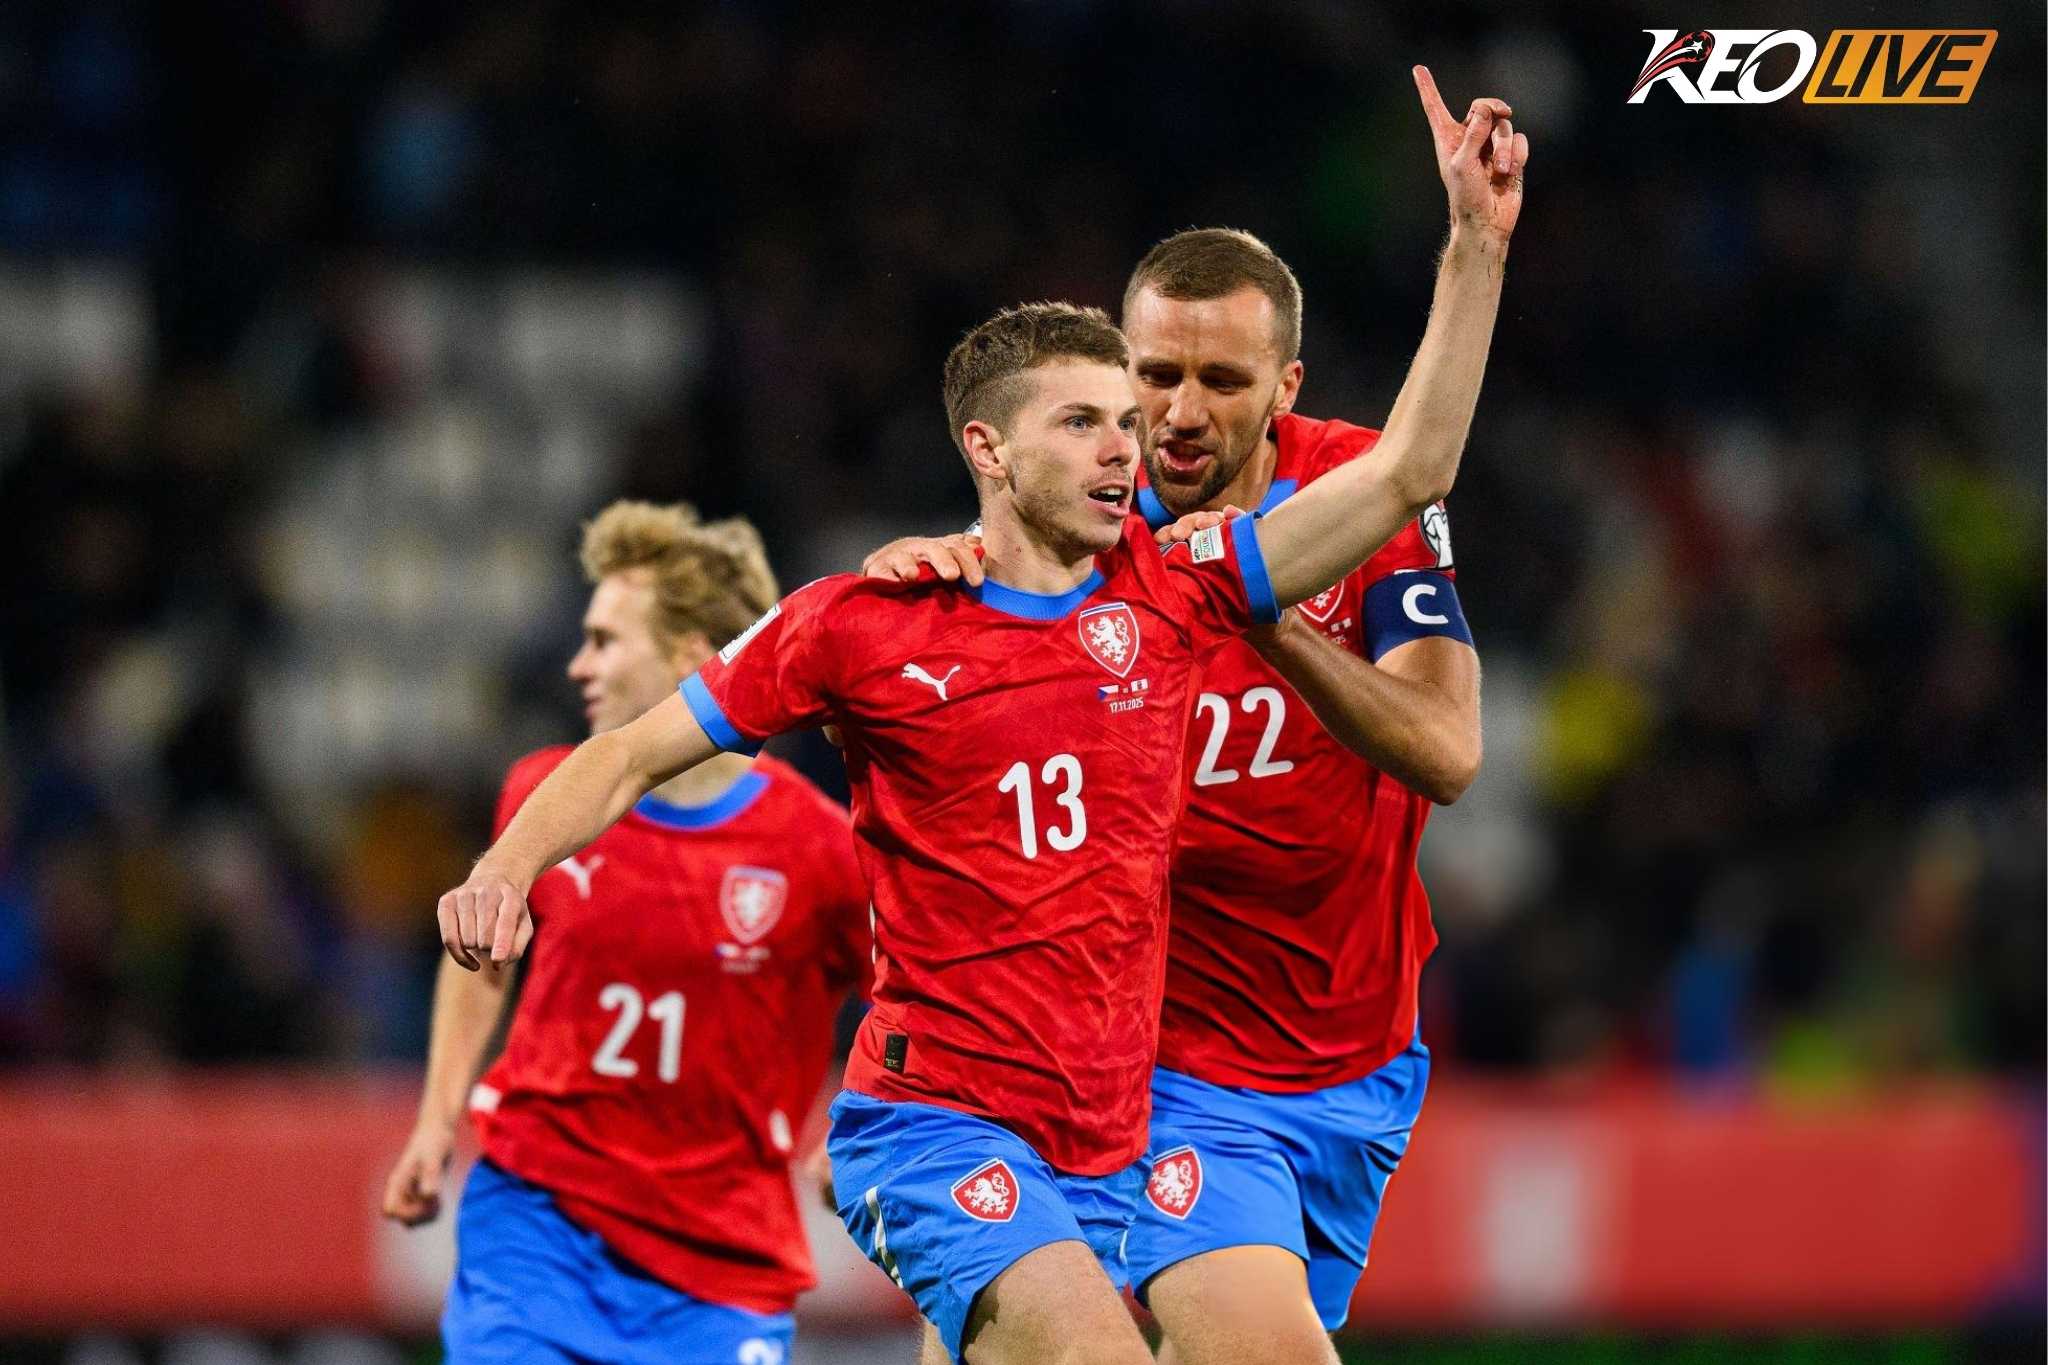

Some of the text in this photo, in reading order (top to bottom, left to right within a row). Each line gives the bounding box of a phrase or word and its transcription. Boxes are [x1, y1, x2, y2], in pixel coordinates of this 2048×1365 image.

[1402, 584, 1449, 625] C
[1109, 696, 1145, 714] 17.11.2025
[1194, 686, 1295, 787] 22
[998, 753, 1088, 860] 13
[591, 982, 687, 1084] 21
